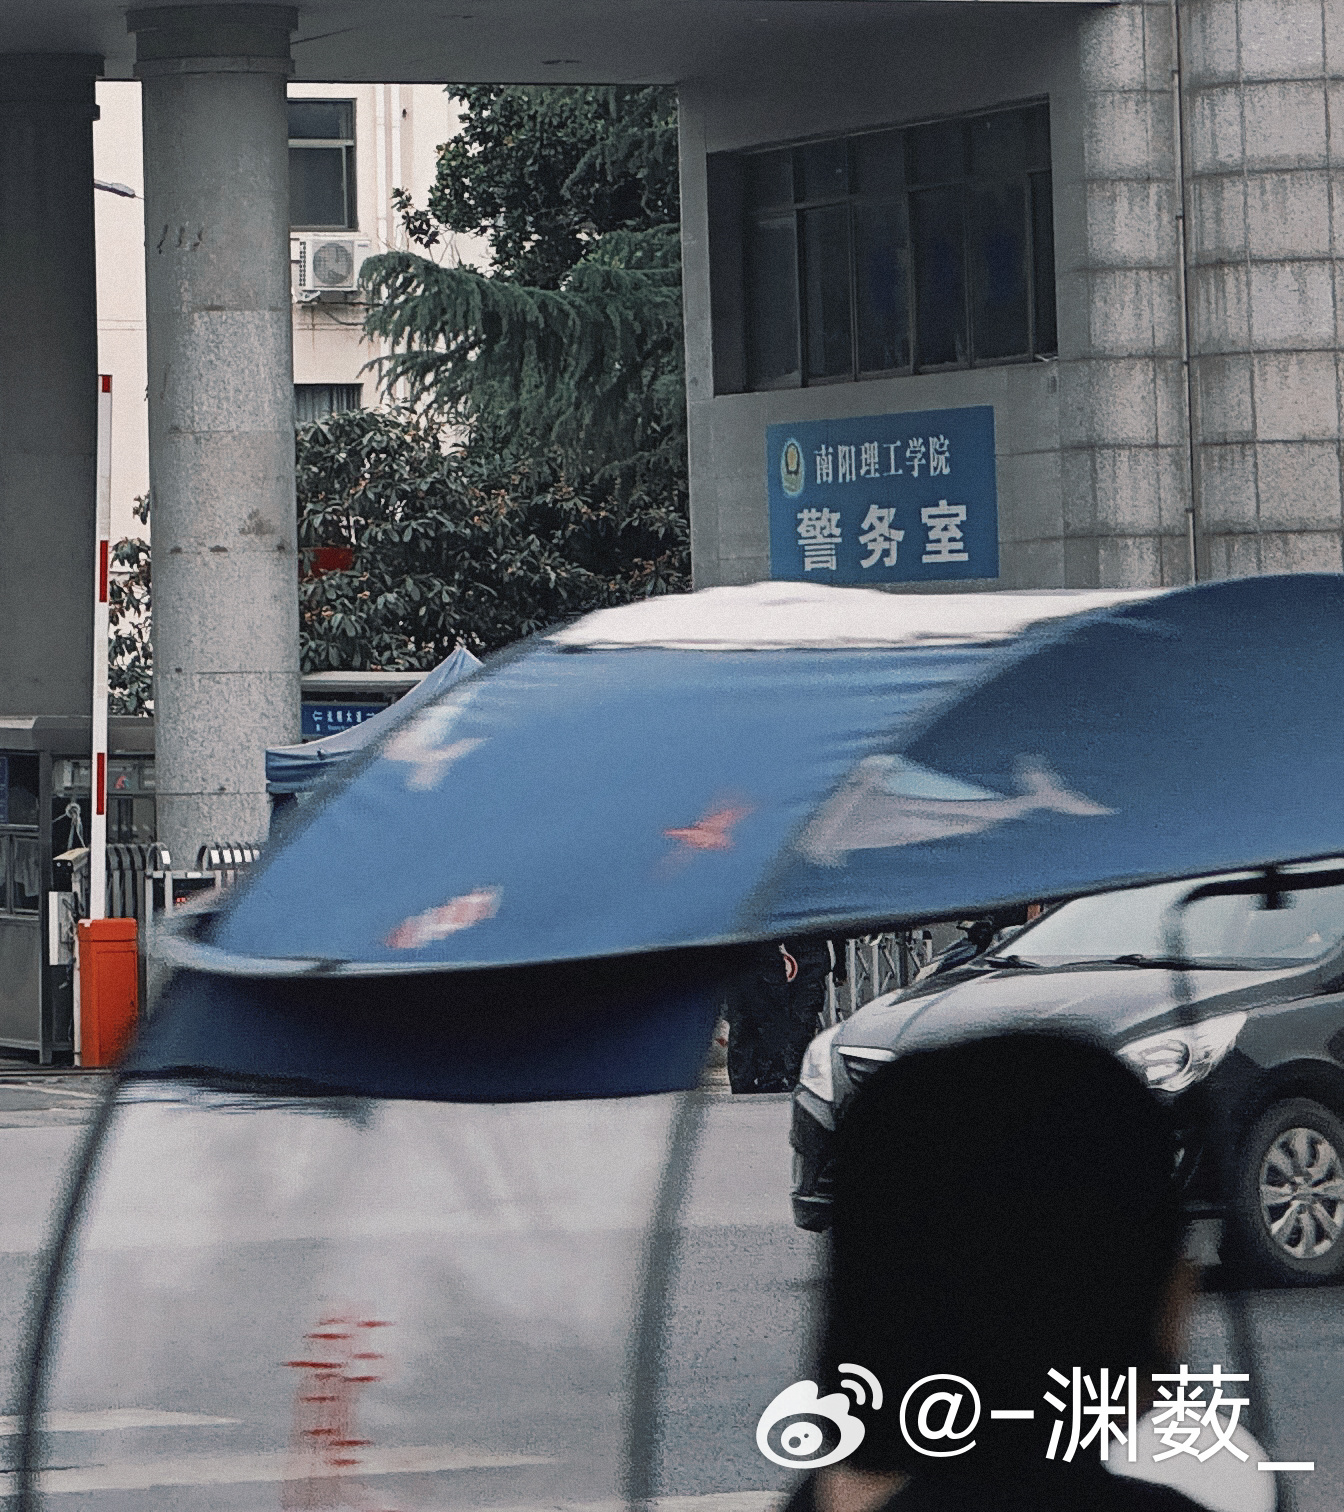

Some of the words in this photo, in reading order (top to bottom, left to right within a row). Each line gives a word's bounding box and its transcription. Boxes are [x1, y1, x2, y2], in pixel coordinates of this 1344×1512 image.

[814, 435, 951, 485] 南阳理工学院
[796, 499, 970, 571] 警务室
